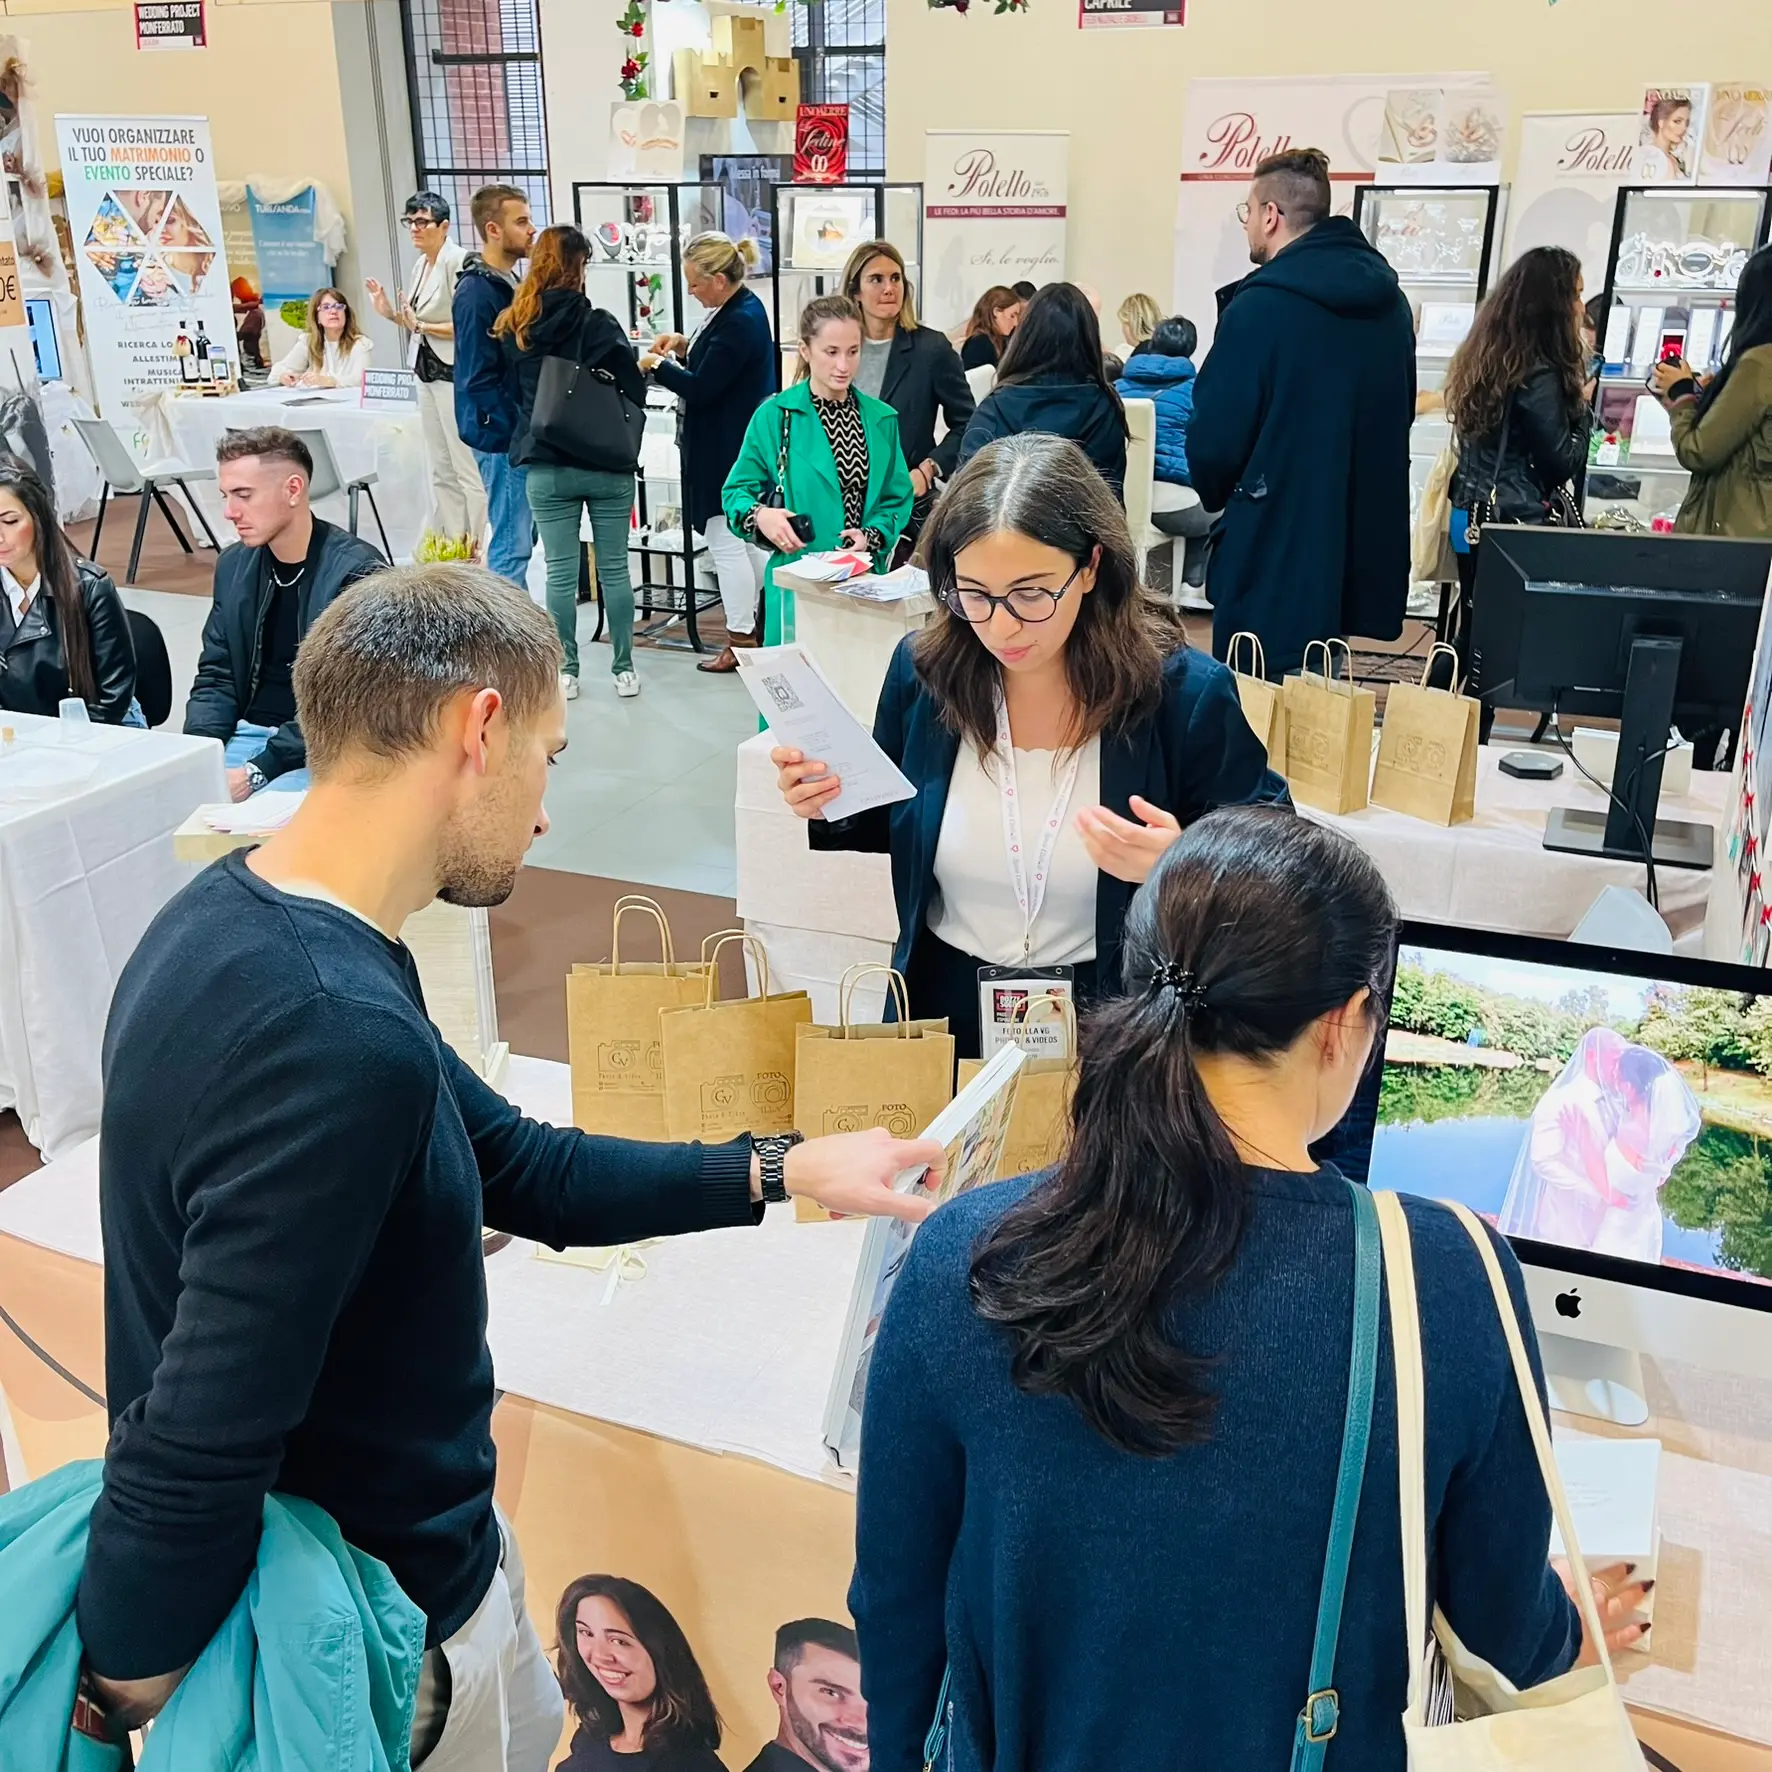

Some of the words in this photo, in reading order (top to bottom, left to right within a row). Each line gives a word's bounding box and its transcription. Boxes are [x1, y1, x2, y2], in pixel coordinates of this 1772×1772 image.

[138, 5, 169, 19] WEDDING
[170, 4, 200, 18] PROJECT
[139, 20, 184, 34] MONFERRATO
[72, 128, 105, 143] VUOI
[109, 128, 195, 144] ORGANIZZARE
[1199, 112, 1292, 168] Polell
[68, 147, 79, 161] IL
[81, 147, 106, 161] TUO
[110, 147, 191, 162] MATRIMONIO
[195, 148, 204, 163] O
[84, 165, 131, 180] EVENTO
[135, 166, 193, 181] SPECIALE?
[948, 149, 1032, 198] Polello
[117, 341, 158, 349] RICERCA
[161, 341, 173, 349] LO
[132, 355, 180, 363] ALLESTIM
[397, 373, 415, 386] PROJ
[364, 385, 409, 399] MONFERRATO
[1032, 1036, 1058, 1044] VIDEOS
[757, 1071, 782, 1080] FOTO
[882, 1103, 907, 1111] FOTO
